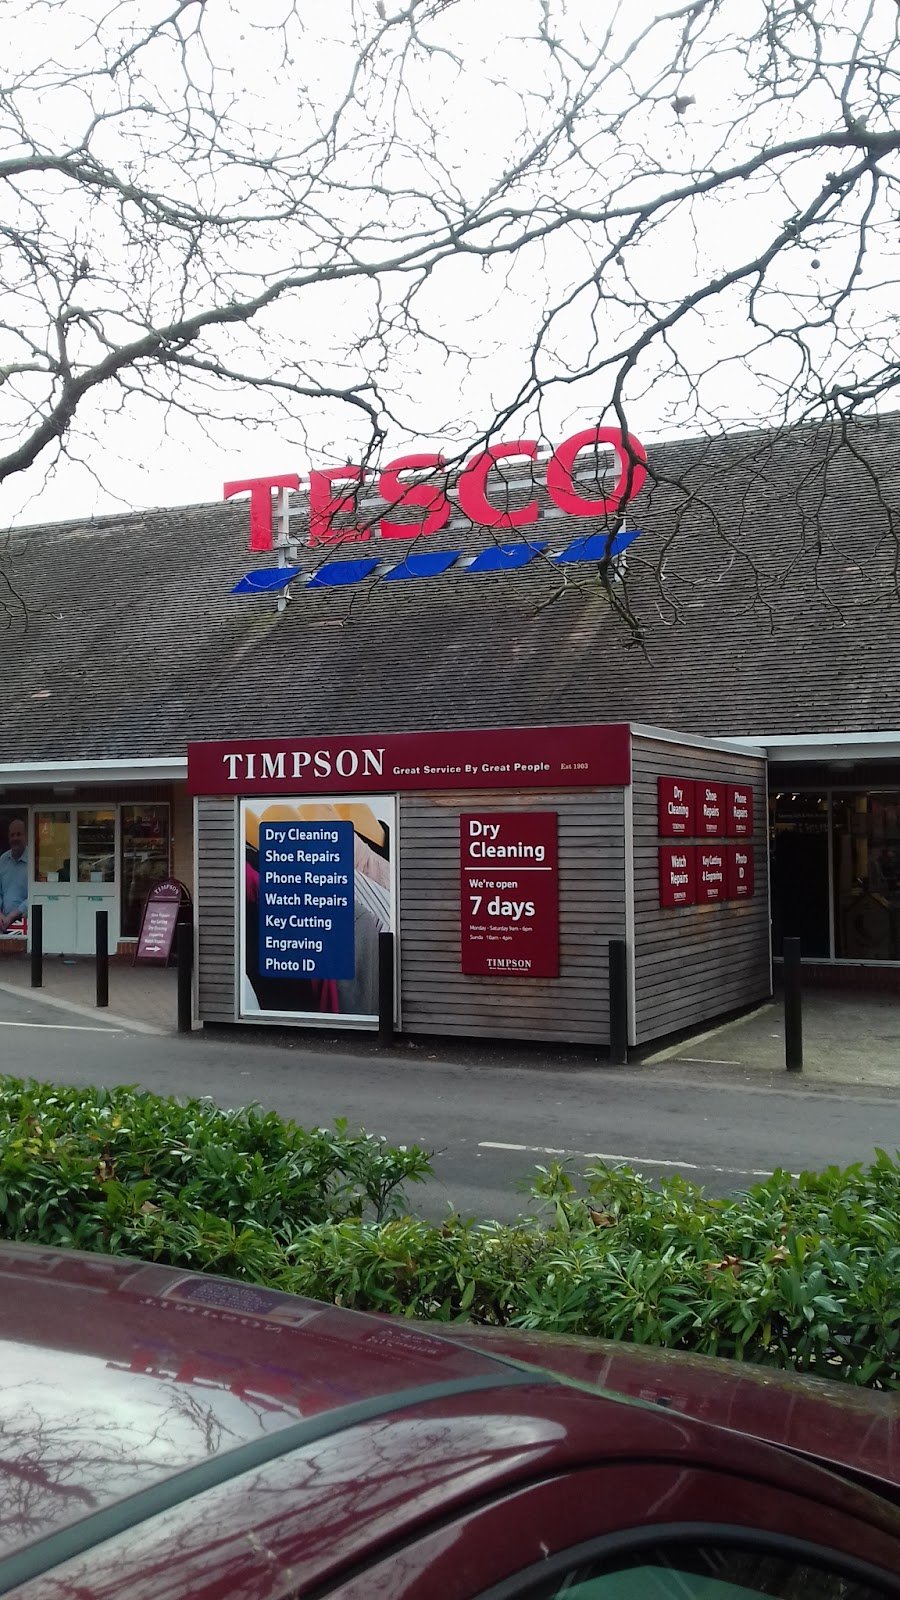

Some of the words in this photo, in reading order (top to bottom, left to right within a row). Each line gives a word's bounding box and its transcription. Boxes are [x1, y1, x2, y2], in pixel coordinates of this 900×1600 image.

[223, 426, 647, 552] TESCO
[222, 748, 386, 780] TIMPSON
[392, 766, 420, 775] Great
[423, 764, 461, 774] Service
[465, 764, 478, 774] By
[481, 763, 510, 773] Great
[514, 762, 550, 773] People
[674, 785, 683, 801] Dry
[705, 788, 718, 802] Shoe
[734, 791, 747, 804] Phone
[668, 802, 688, 818] Cleaning
[703, 803, 720, 819] Repairs
[733, 805, 748, 820] Repairs
[265, 828, 286, 843] Dry
[288, 828, 339, 843] Cleaning
[469, 820, 501, 840] Dry
[265, 850, 294, 862] Shoe
[296, 850, 340, 865] Repairs
[469, 841, 545, 862] Cleaning
[735, 852, 748, 864] Photo
[671, 855, 686, 868] Watch
[265, 871, 302, 884] Phone
[304, 871, 348, 887] Repairs
[469, 878, 494, 888] We're
[495, 881, 518, 890] open
[670, 871, 689, 886] Repairs
[706, 871, 723, 882] Engraving
[265, 893, 301, 905] Watch
[304, 893, 348, 909] Repairs
[469, 895, 482, 915] 7
[487, 895, 536, 921] days
[265, 914, 287, 929] Key
[289, 915, 332, 930] Cutting
[265, 936, 323, 952] Engraving
[265, 958, 300, 971] Photo
[302, 959, 316, 971] ID
[486, 958, 532, 968] TIMPSON
